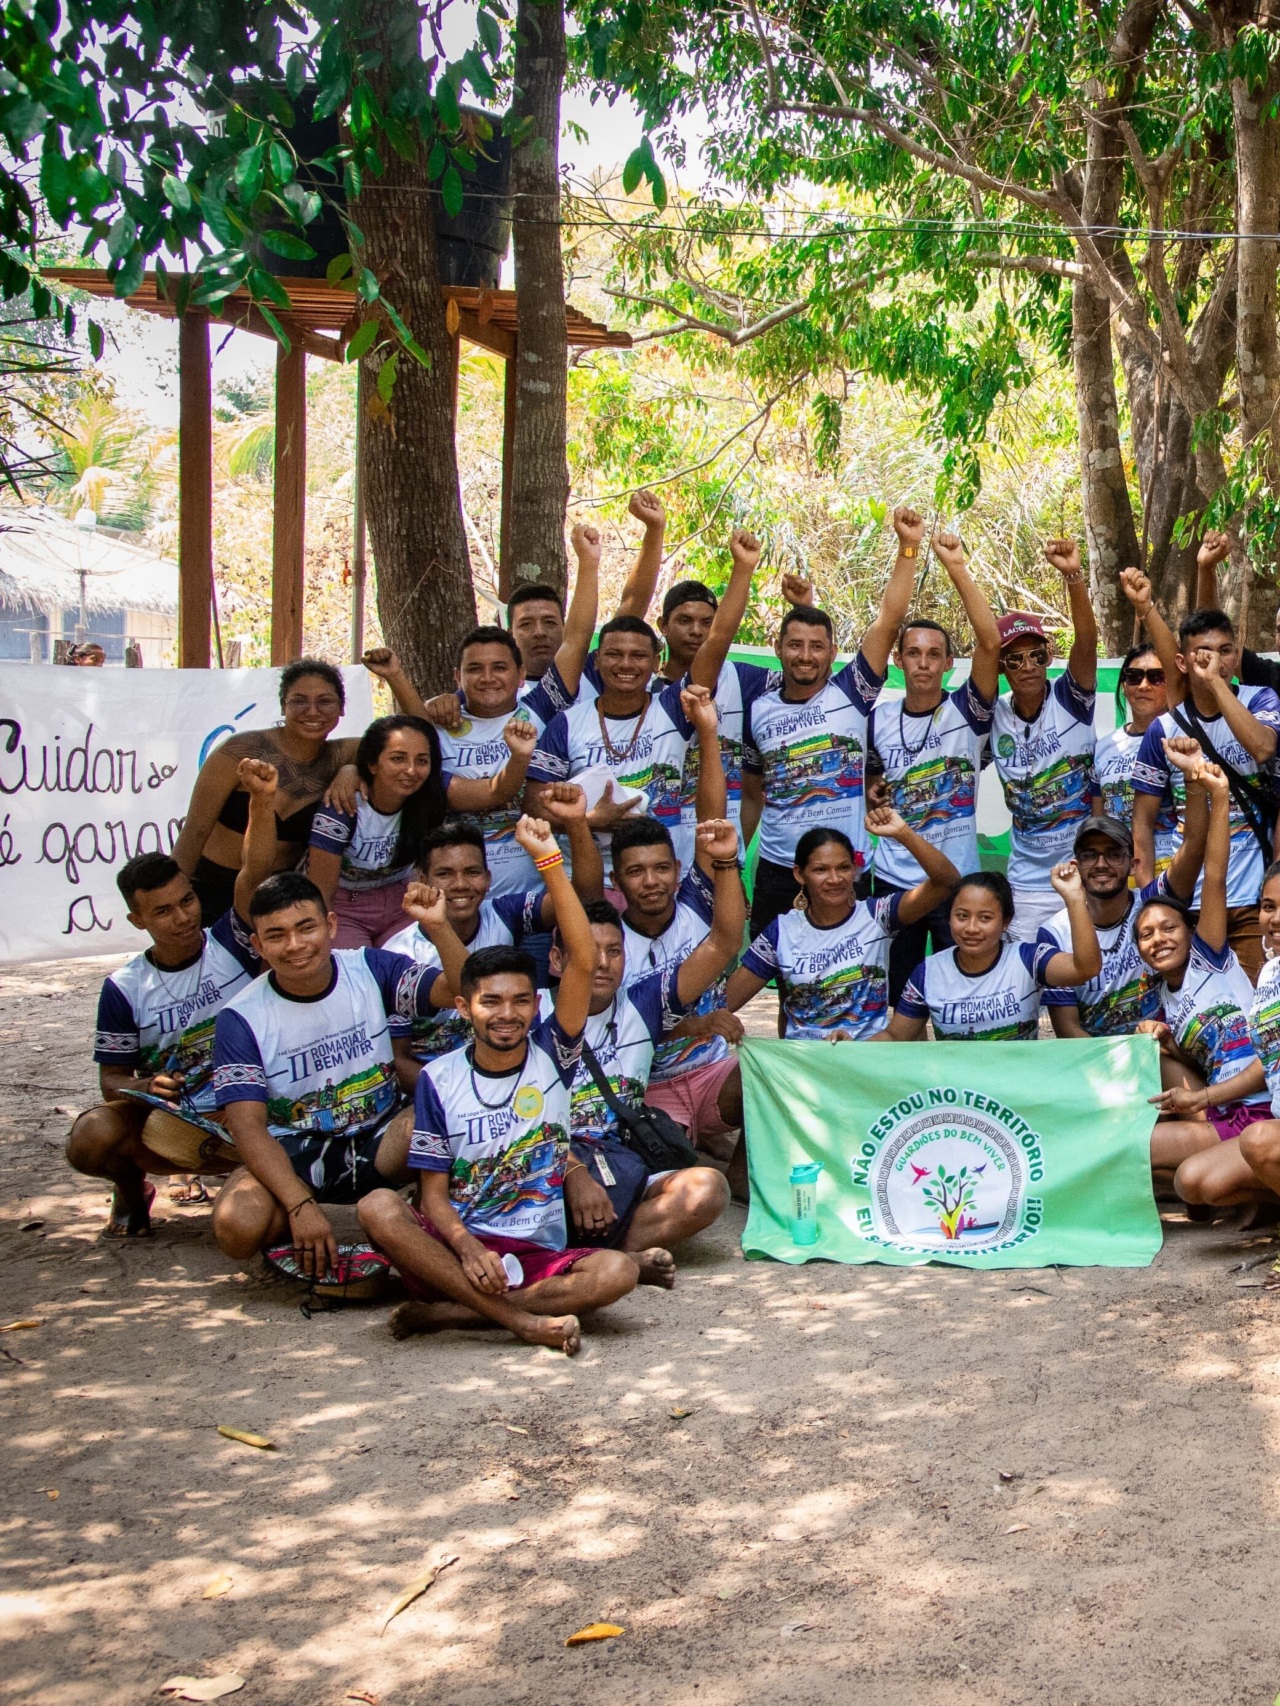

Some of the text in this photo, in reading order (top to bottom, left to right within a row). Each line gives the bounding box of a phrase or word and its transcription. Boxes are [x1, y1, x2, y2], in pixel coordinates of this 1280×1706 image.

[1003, 625, 1040, 637] LACOSTE
[776, 724, 797, 737] BEM
[455, 747, 476, 768] II
[807, 807, 824, 818] Bem
[503, 844, 522, 855] Bem
[62, 895, 113, 935] a
[156, 979, 215, 1035] II DO
[941, 1002, 960, 1025] II
[960, 998, 1002, 1013] ROMARIA
[1003, 992, 1016, 1004] DO
[960, 1002, 1021, 1024] BEM VIVER
[287, 1050, 313, 1083] II
[310, 1031, 360, 1061] ROMARIA
[314, 1052, 344, 1072] BEM
[465, 1115, 488, 1146] II
[853, 1088, 1044, 1186] NÃO ESTOU NO TERRITÓRIO
[895, 1128, 1007, 1173] GUARDIÕES DO BEM VIVER
[509, 1217, 531, 1227] Bem
[856, 1206, 875, 1234] EU
